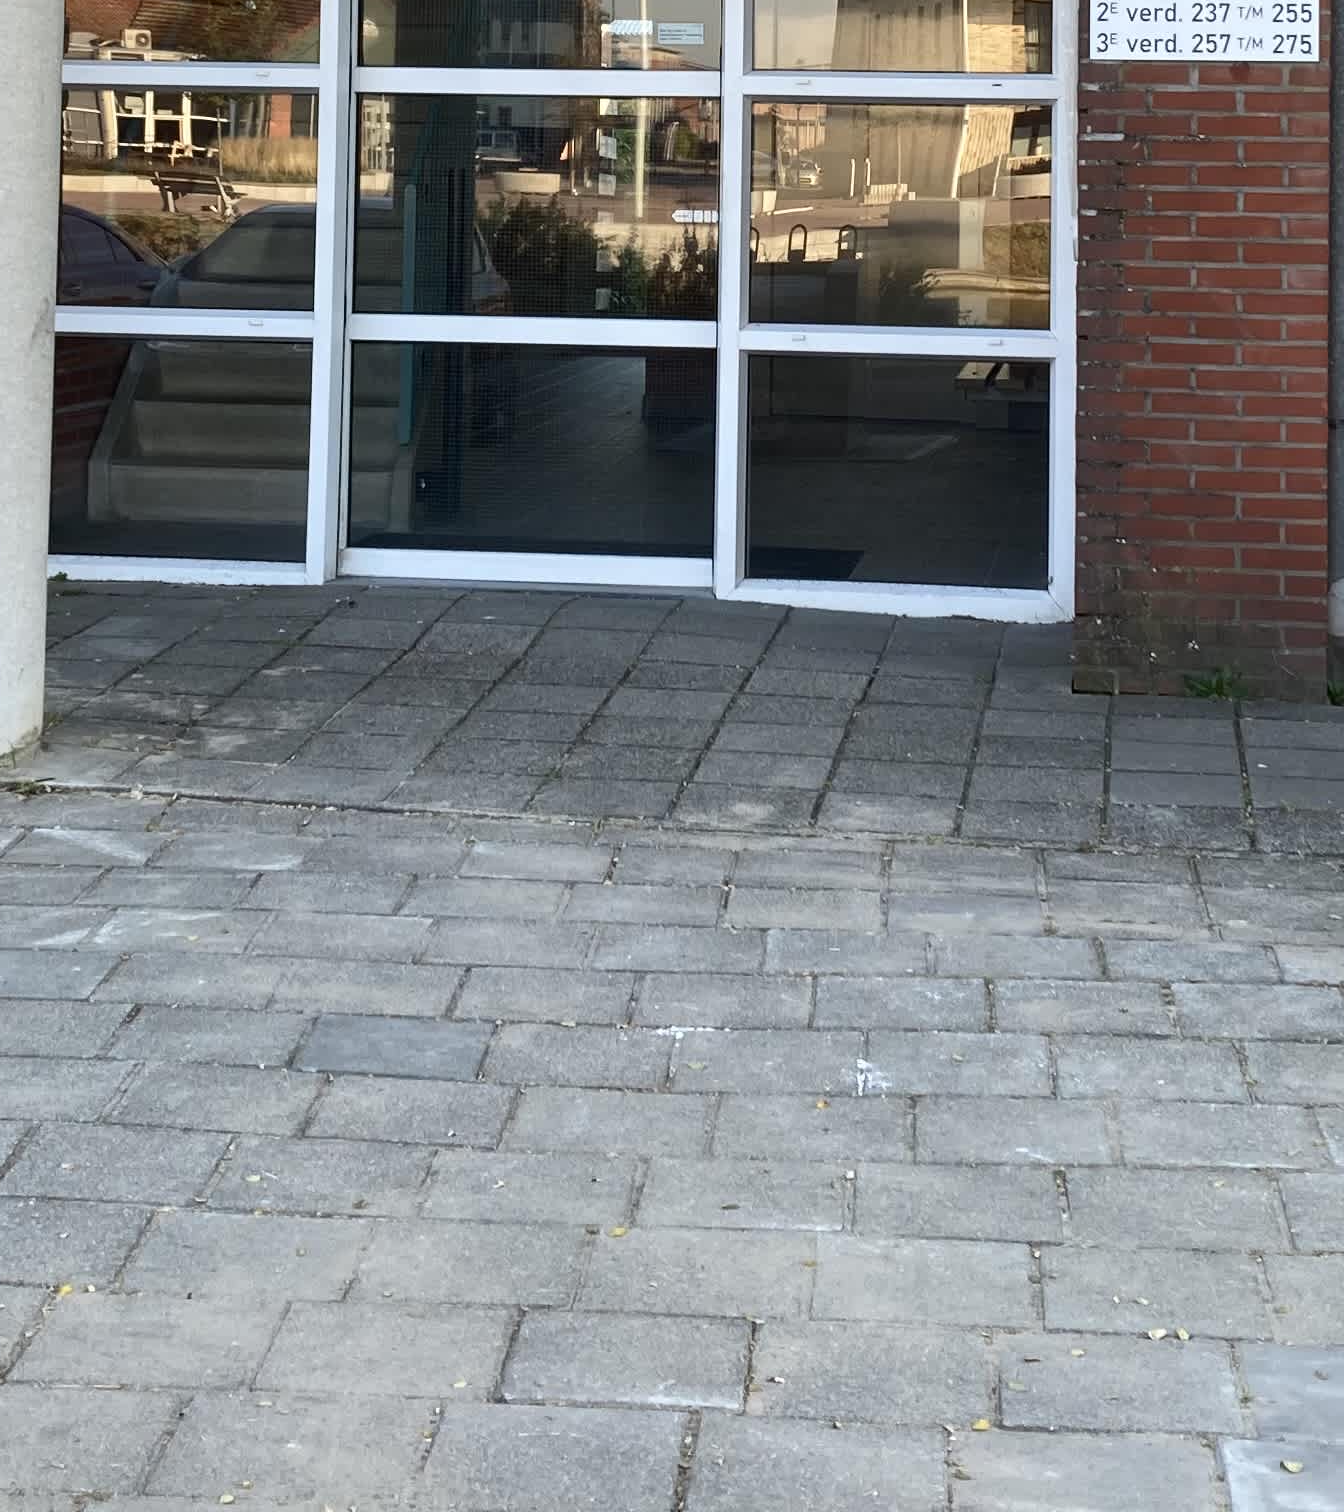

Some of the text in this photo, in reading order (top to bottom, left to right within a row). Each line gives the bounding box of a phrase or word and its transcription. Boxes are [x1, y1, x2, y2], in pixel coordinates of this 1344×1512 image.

[1126, 2, 1183, 22] verd.
[1191, 2, 1231, 23] 237
[1236, 5, 1264, 20] T/M
[1271, 3, 1313, 23] 255
[1126, 33, 1183, 53] verd.
[1191, 33, 1231, 54] 257
[1236, 36, 1264, 50] T/M
[1272, 34, 1313, 55] 275
